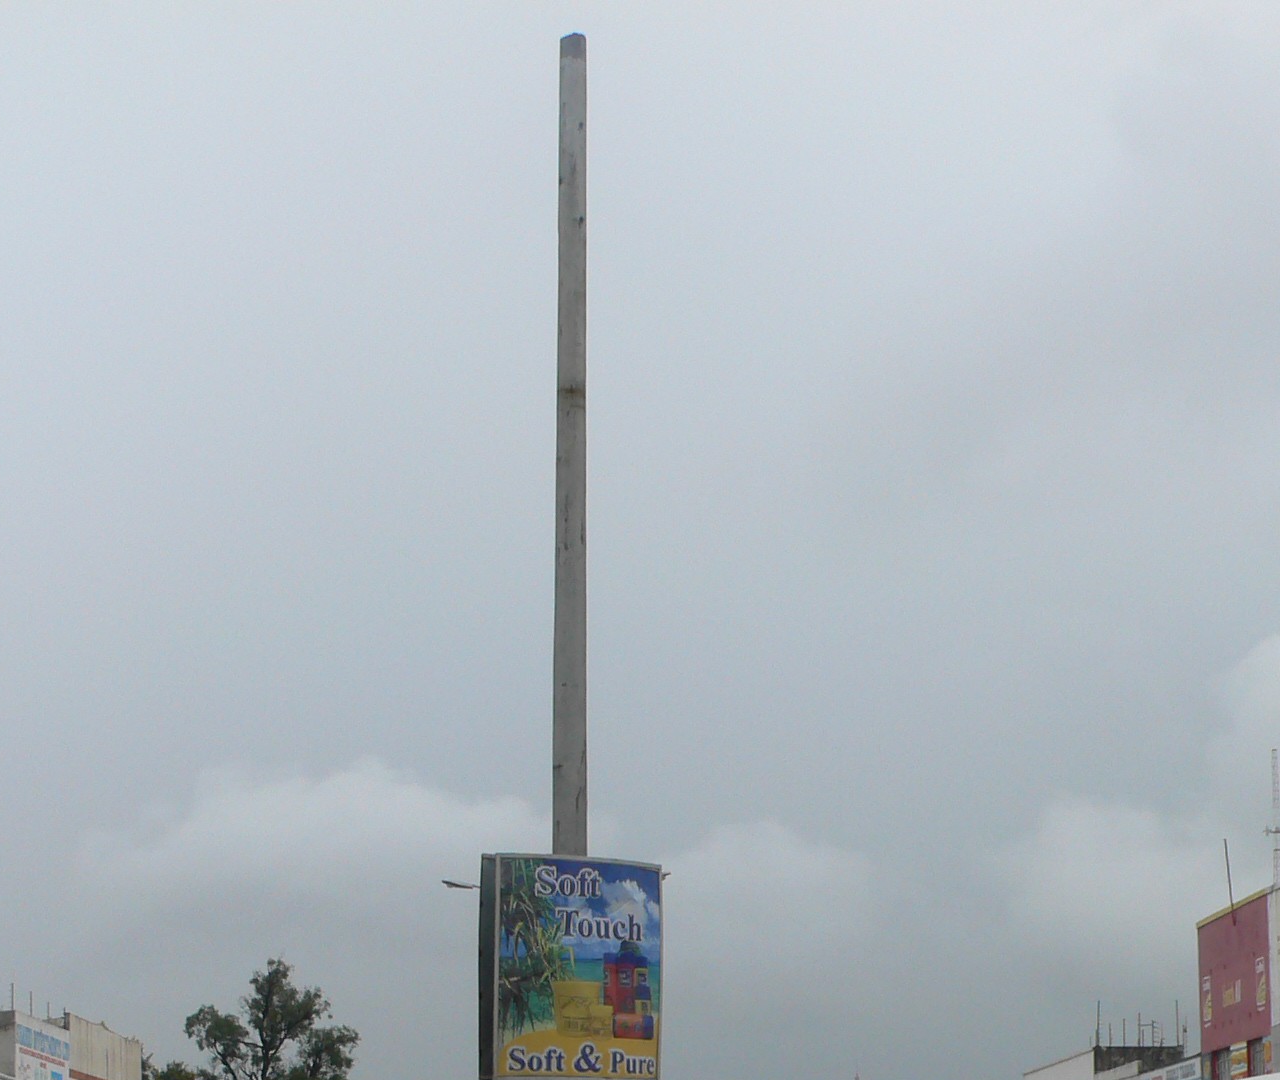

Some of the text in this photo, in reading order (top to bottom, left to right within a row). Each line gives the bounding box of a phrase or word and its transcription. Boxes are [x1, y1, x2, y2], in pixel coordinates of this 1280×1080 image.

[535, 865, 601, 897] Soft
[555, 907, 643, 941] Touch
[508, 1044, 655, 1075] Soft & Pure
